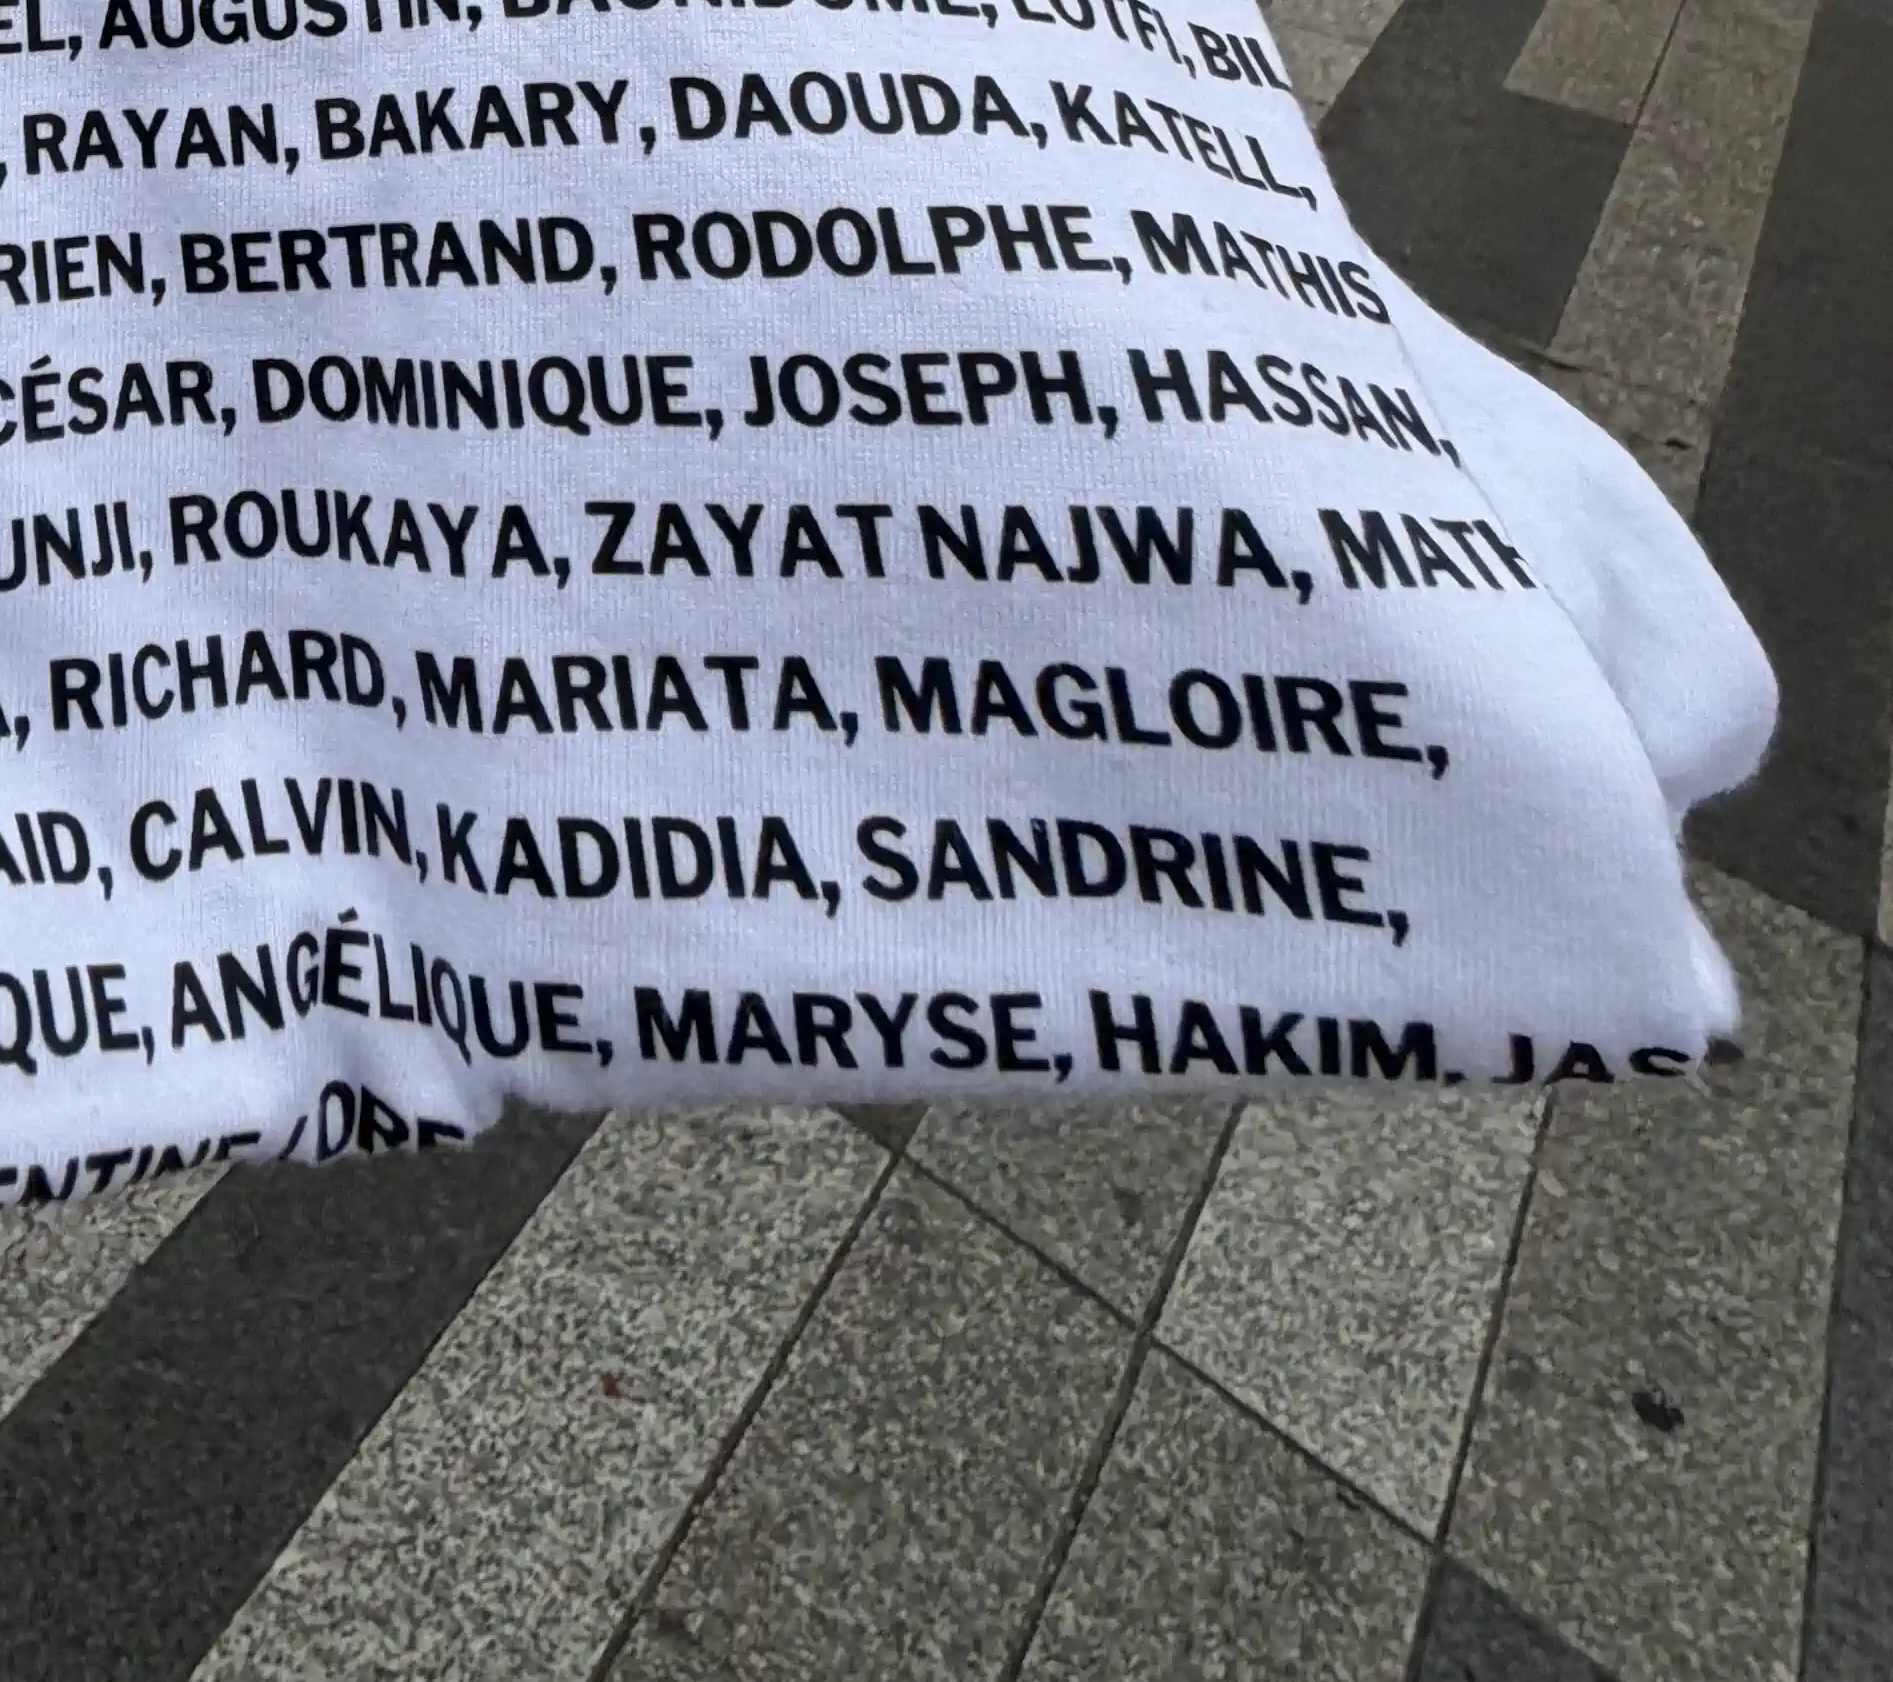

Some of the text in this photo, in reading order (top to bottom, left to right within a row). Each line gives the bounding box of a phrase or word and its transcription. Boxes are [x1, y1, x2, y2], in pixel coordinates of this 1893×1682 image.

[22, 101, 301, 177] RAYAN,
[313, 77, 658, 162] BAKARY,
[668, 70, 1049, 150] DAOUDA,
[1048, 79, 1318, 212] KATELL,
[178, 215, 619, 298] BERTRAND,
[630, 203, 1134, 286] RODOLPHE,
[1129, 209, 1392, 326] MATHIS
[250, 353, 726, 443] DOMINIQUE,
[742, 349, 1120, 441] JOSEPH,
[1125, 347, 1462, 469] HASSAN,
[167, 487, 573, 591] ROUKAYA,
[583, 499, 895, 581] ZAYAT
[915, 503, 1315, 607] NAJWA,
[48, 627, 408, 733] RICHARD,
[413, 648, 860, 749] MARIATA,
[872, 653, 1451, 782] MAGLOIRE,
[128, 776, 430, 885] CALVIN,
[434, 801, 842, 920] KADIDIA,
[855, 814, 1412, 949] SANDRINE,
[170, 905, 617, 1073] ANGÉLIQUE,
[632, 984, 1076, 1088] MARYSE,
